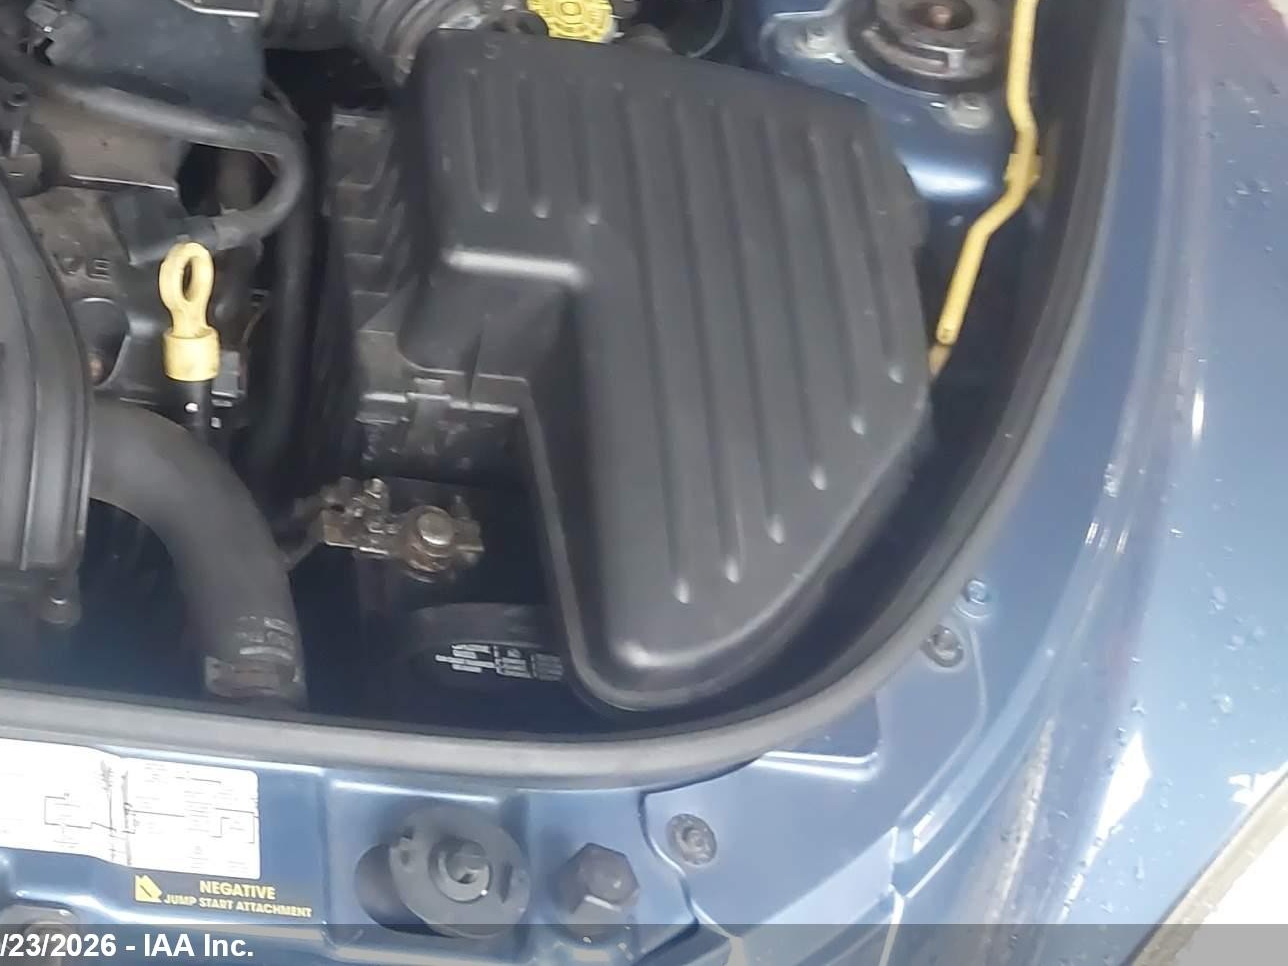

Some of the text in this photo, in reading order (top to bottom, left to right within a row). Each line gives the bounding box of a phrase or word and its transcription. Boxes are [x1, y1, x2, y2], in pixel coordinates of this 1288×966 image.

[199, 880, 276, 900] NEGATIVE
[164, 894, 312, 918] JUMP START ATTACHMENT
